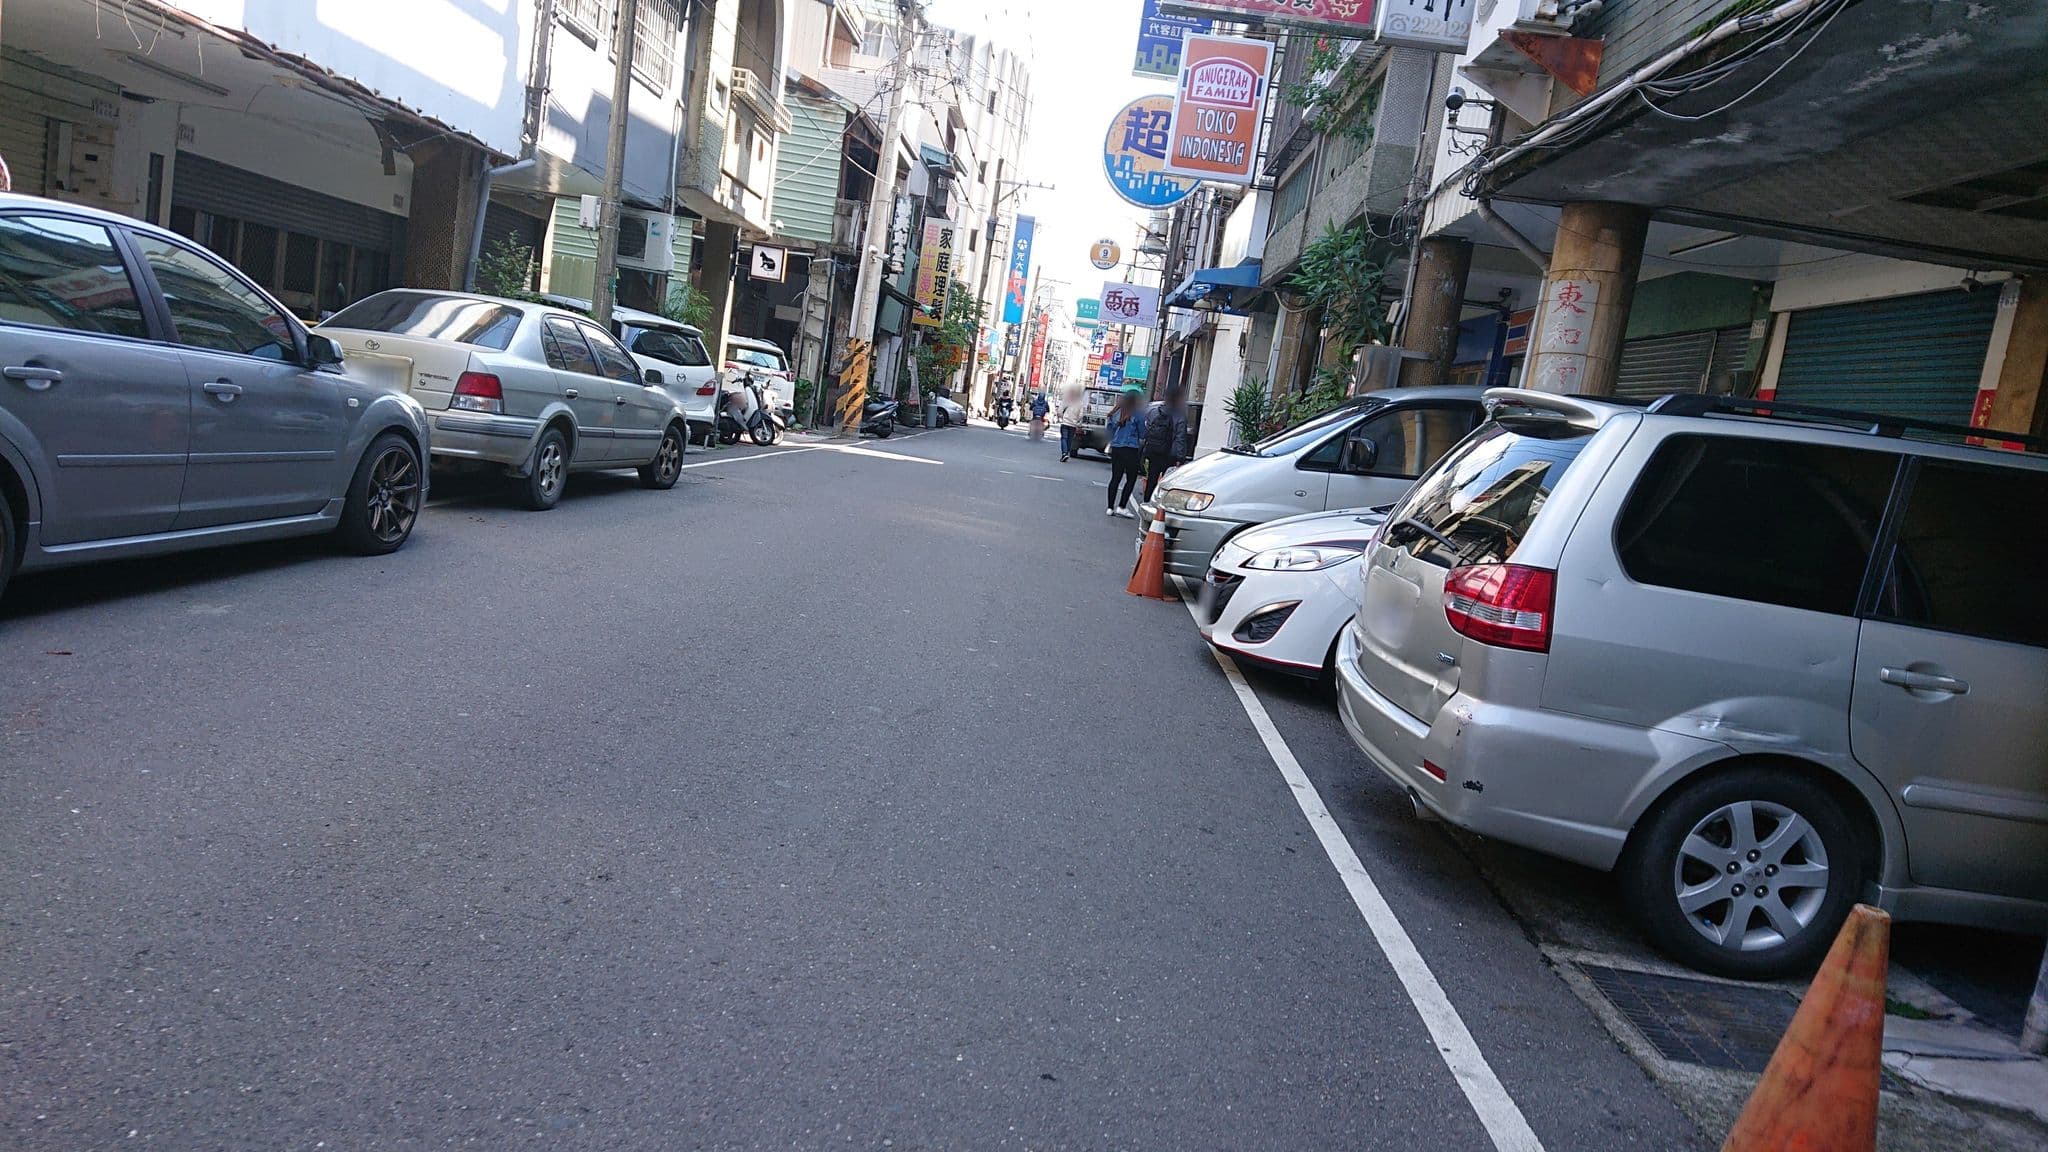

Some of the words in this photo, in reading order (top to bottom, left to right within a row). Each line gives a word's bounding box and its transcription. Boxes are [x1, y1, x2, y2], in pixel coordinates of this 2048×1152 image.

[1197, 67, 1249, 88] ANUGERAH
[1195, 85, 1249, 100] FAMILY
[1122, 107, 1172, 159] 超
[1195, 108, 1238, 136] TOKO
[1179, 135, 1246, 166] INDONESIA
[930, 226, 953, 322] 家庭理髮
[1113, 352, 1122, 361] P
[1110, 370, 1117, 381] P
